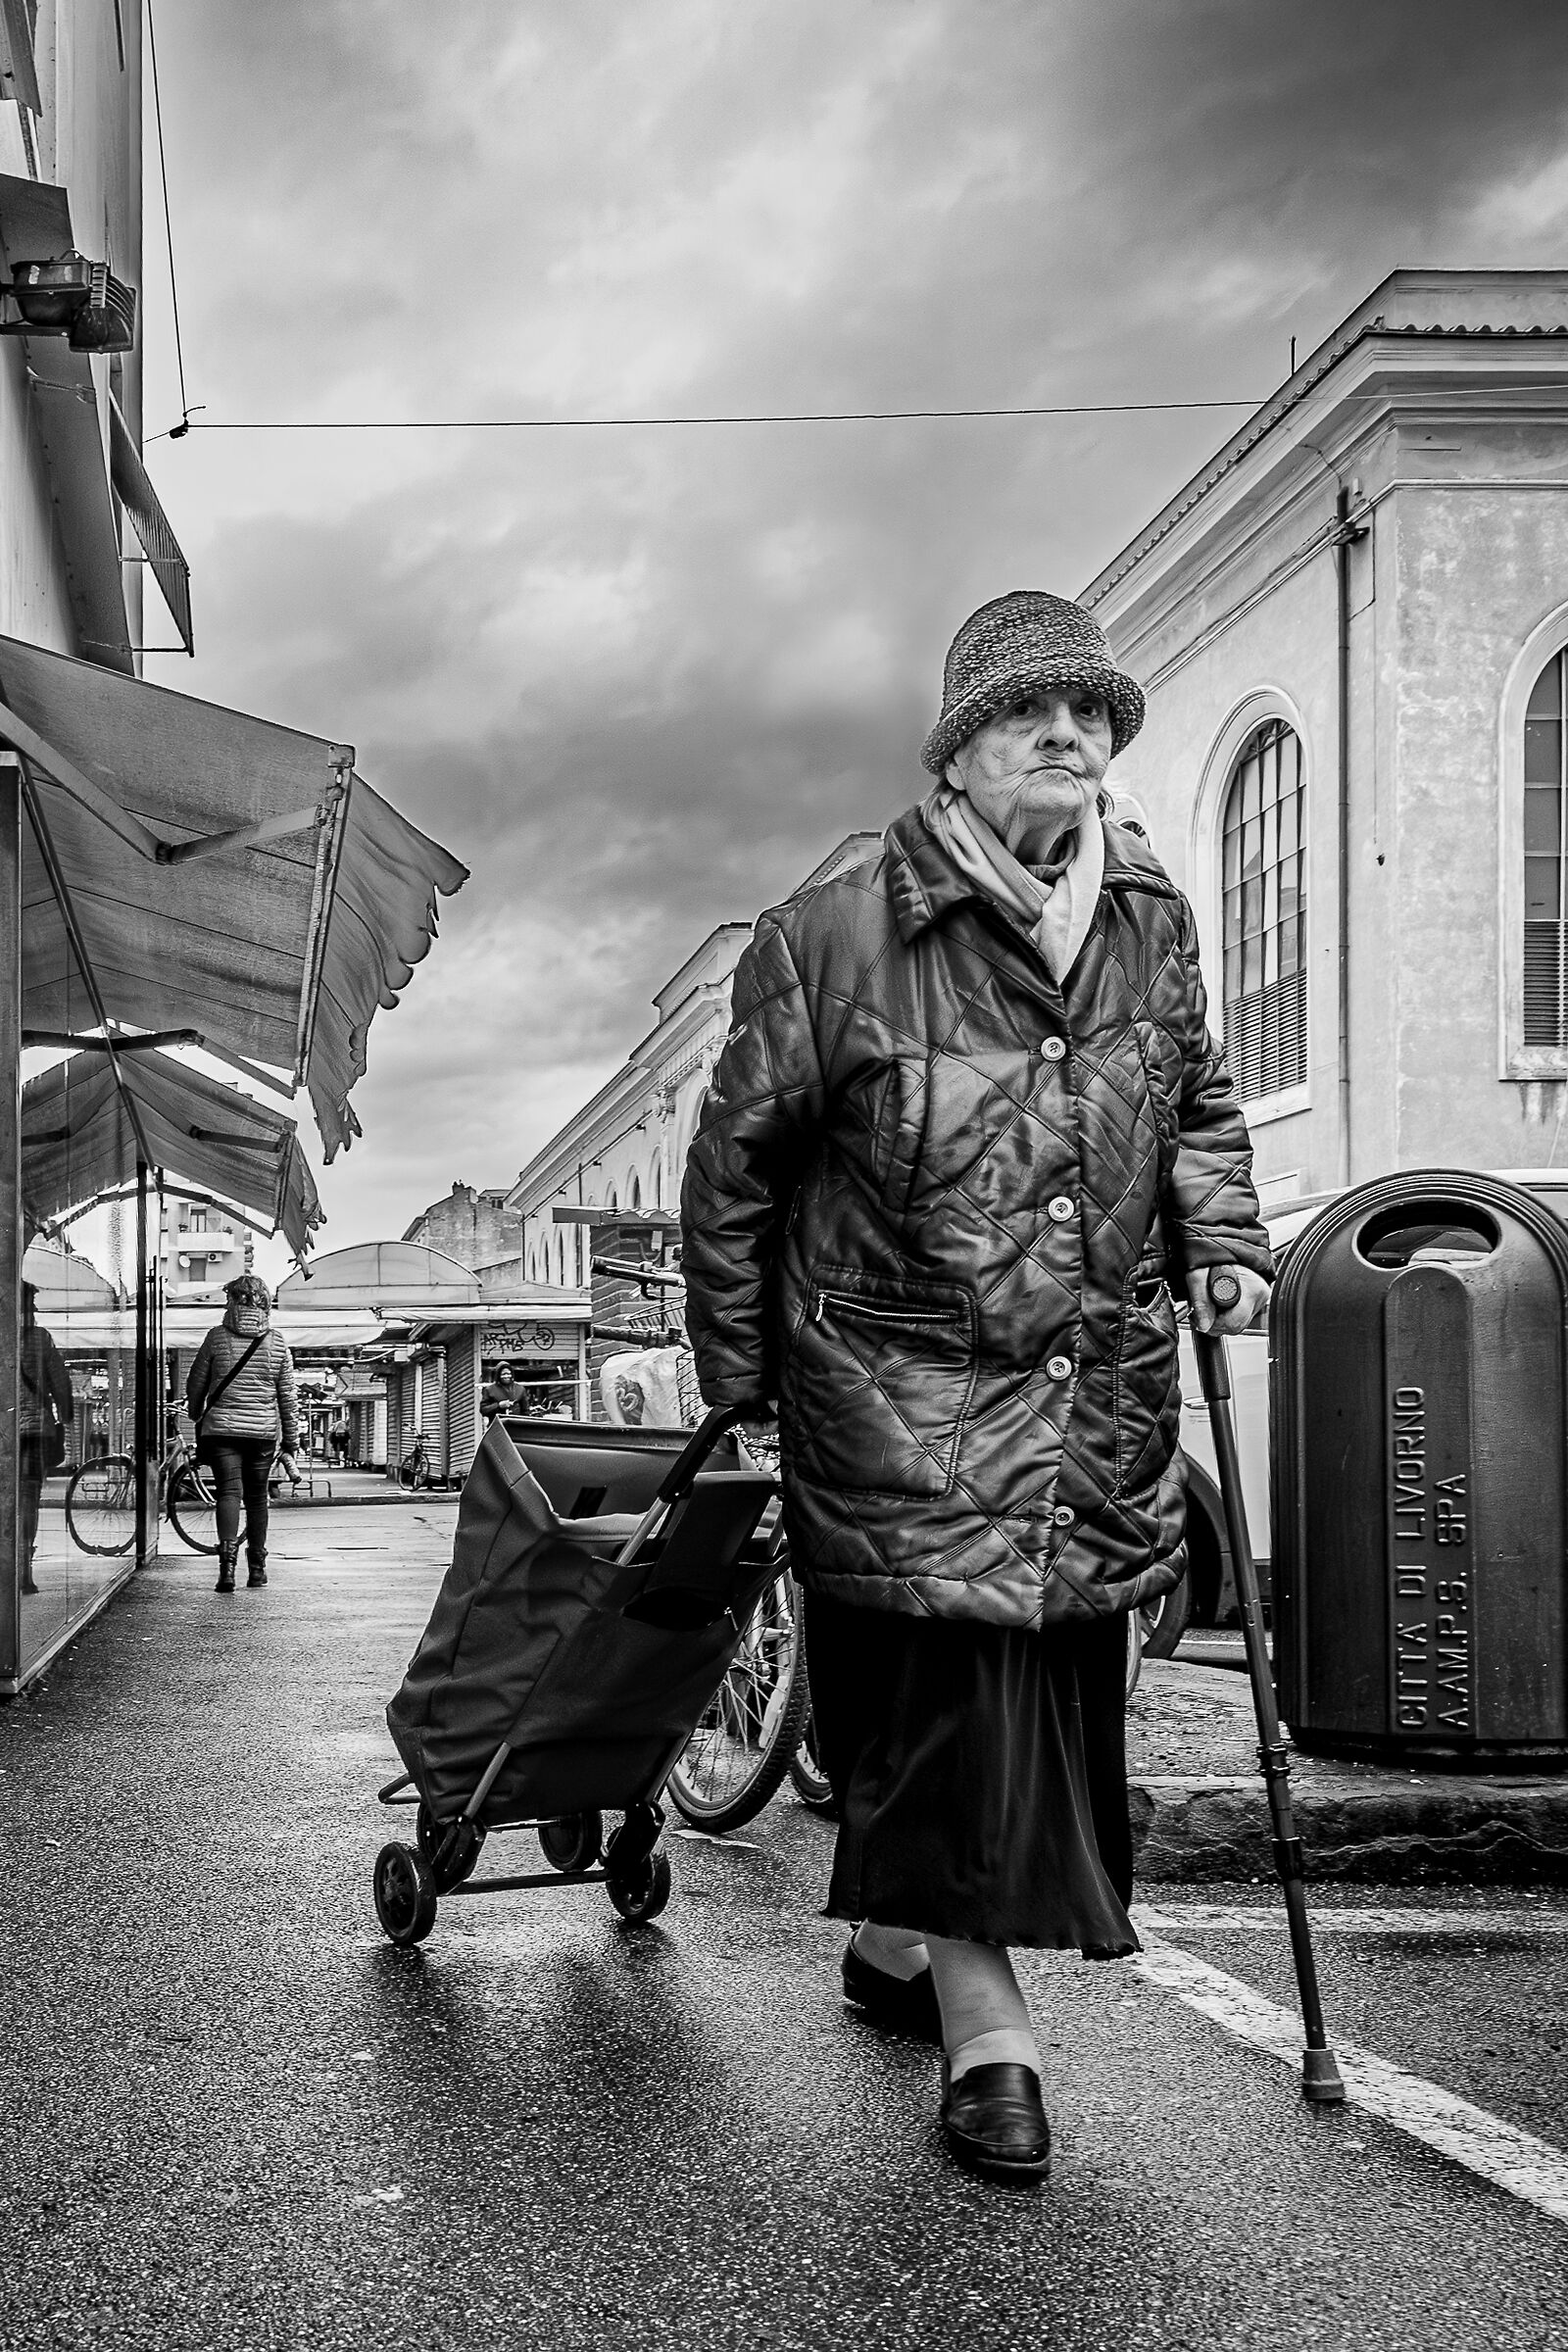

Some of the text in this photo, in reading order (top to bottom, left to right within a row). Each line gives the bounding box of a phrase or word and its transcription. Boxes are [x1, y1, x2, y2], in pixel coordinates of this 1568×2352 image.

[1393, 1386, 1426, 1541] LIVORNO
[1434, 1473, 1467, 1545] SPA
[1395, 1565, 1427, 1597] DI
